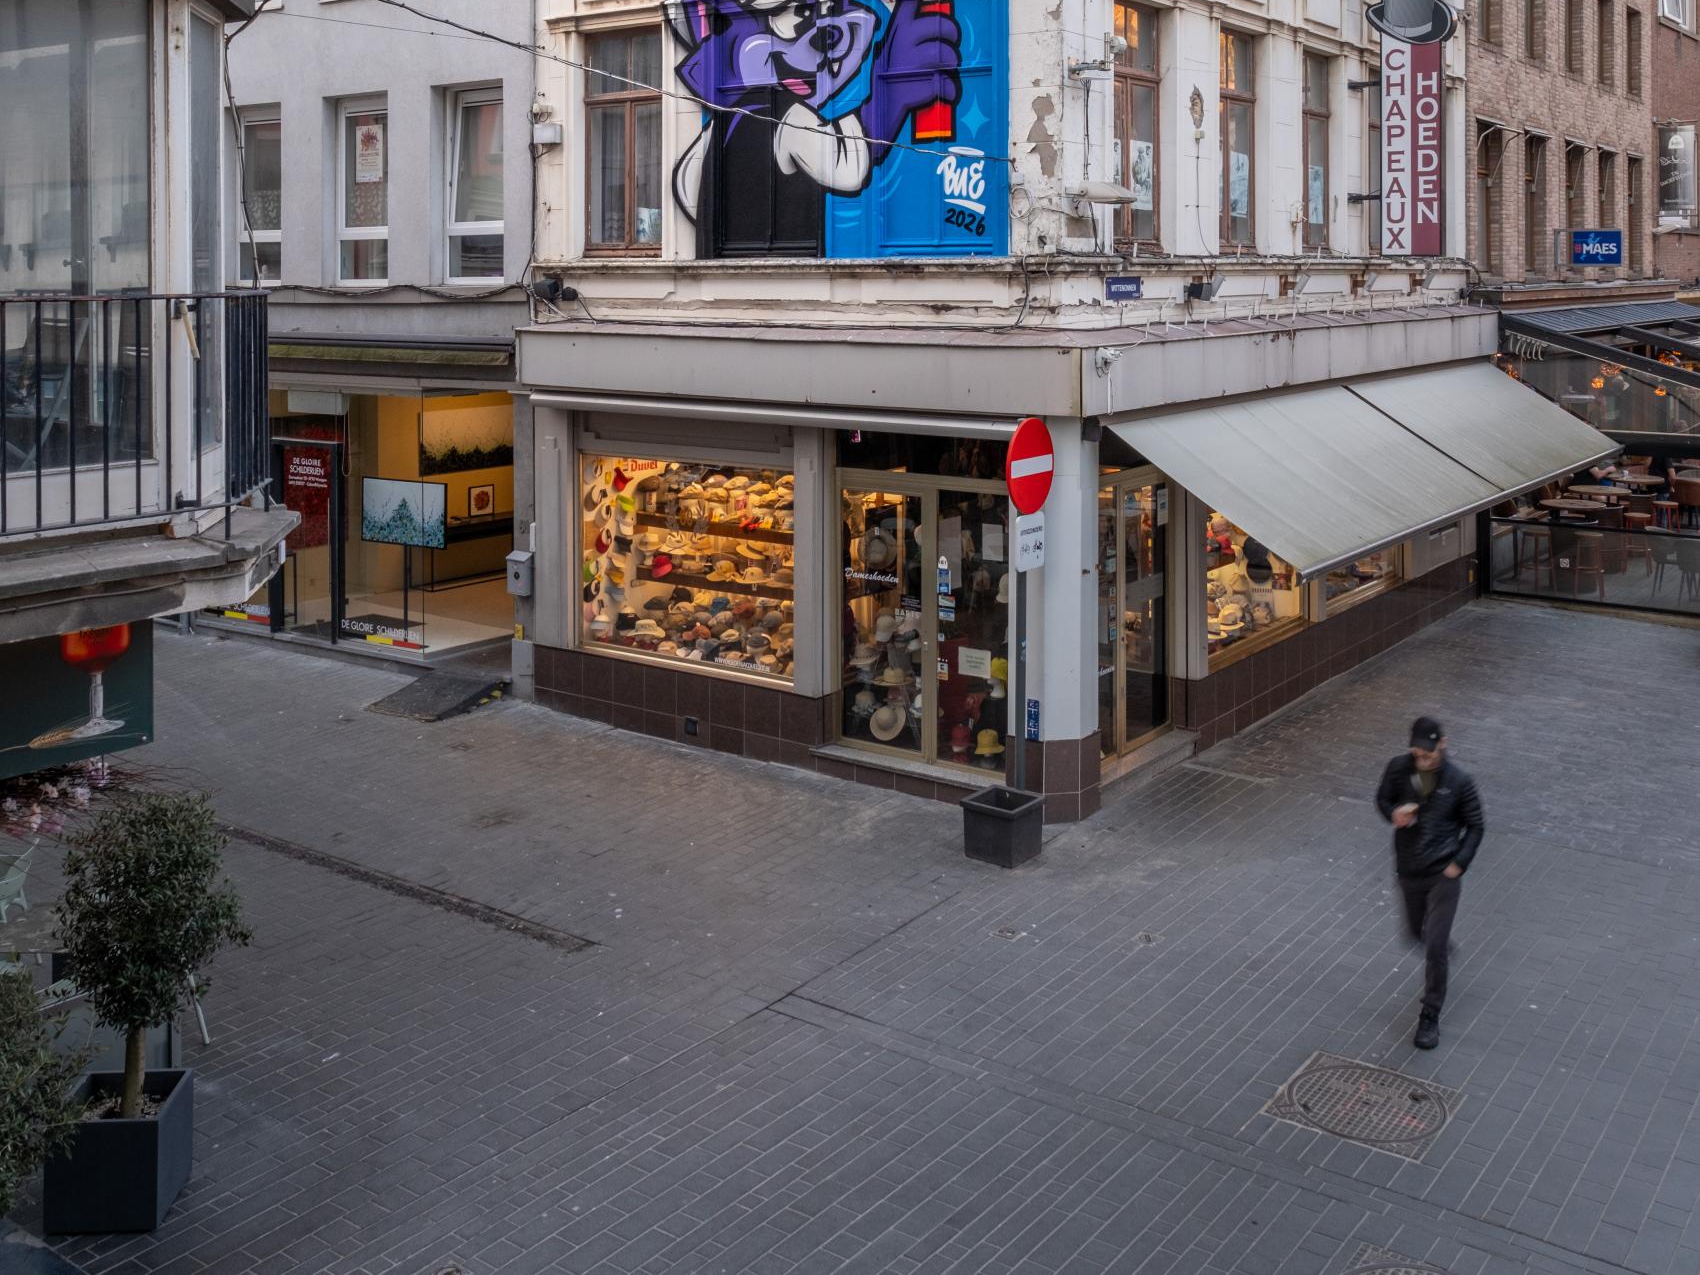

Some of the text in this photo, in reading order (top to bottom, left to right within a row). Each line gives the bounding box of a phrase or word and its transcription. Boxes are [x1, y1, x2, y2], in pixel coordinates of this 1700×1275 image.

[1385, 48, 1408, 250] CHAPEAUX
[1416, 71, 1439, 224] HOEDEN
[1582, 242, 1618, 255] MAES
[630, 459, 658, 472] Duvel
[844, 566, 900, 584] Dameshoeden
[341, 619, 350, 629] DE
[350, 620, 374, 634] GLOIRE
